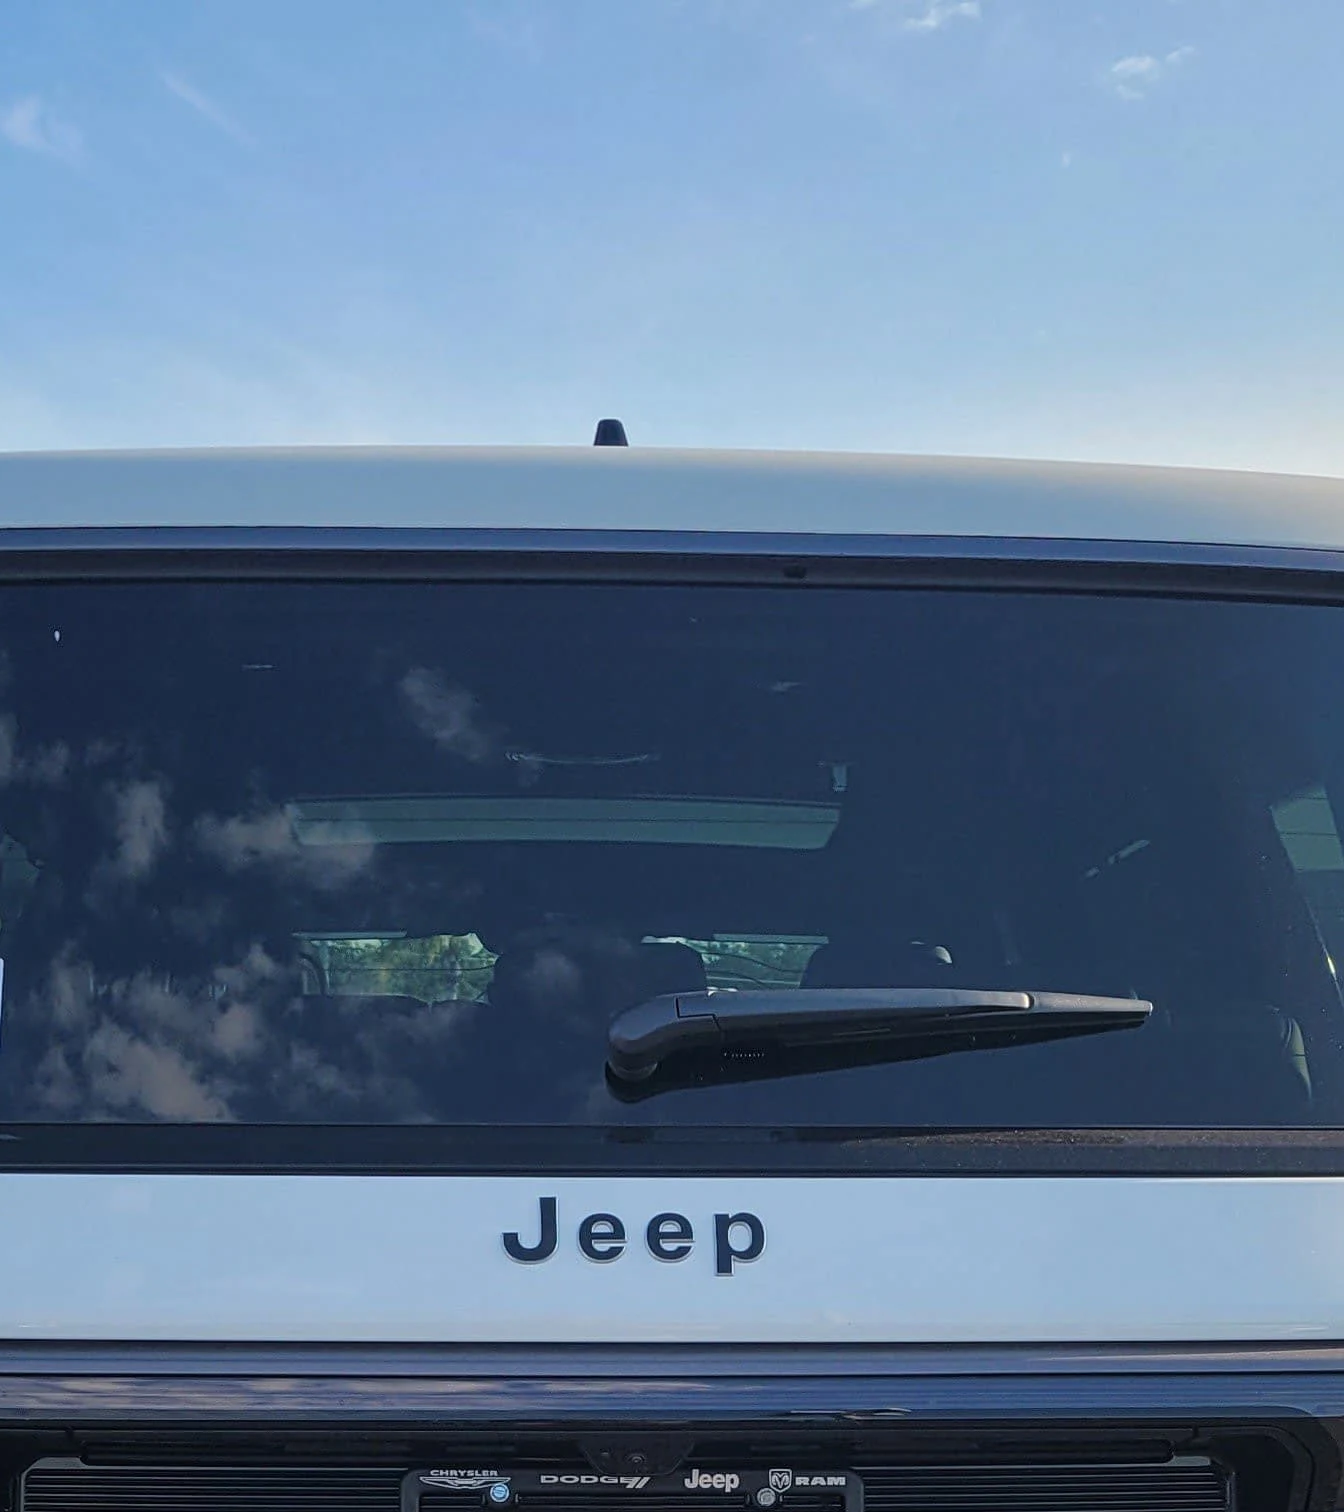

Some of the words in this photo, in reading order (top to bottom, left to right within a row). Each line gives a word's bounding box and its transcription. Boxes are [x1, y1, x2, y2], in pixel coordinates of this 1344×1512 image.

[501, 1196, 767, 1276] Jeep
[430, 1469, 498, 1477] CHRYSLER
[540, 1475, 632, 1484] DODGE
[684, 1468, 740, 1493] Jeep
[794, 1476, 846, 1486] RAM
